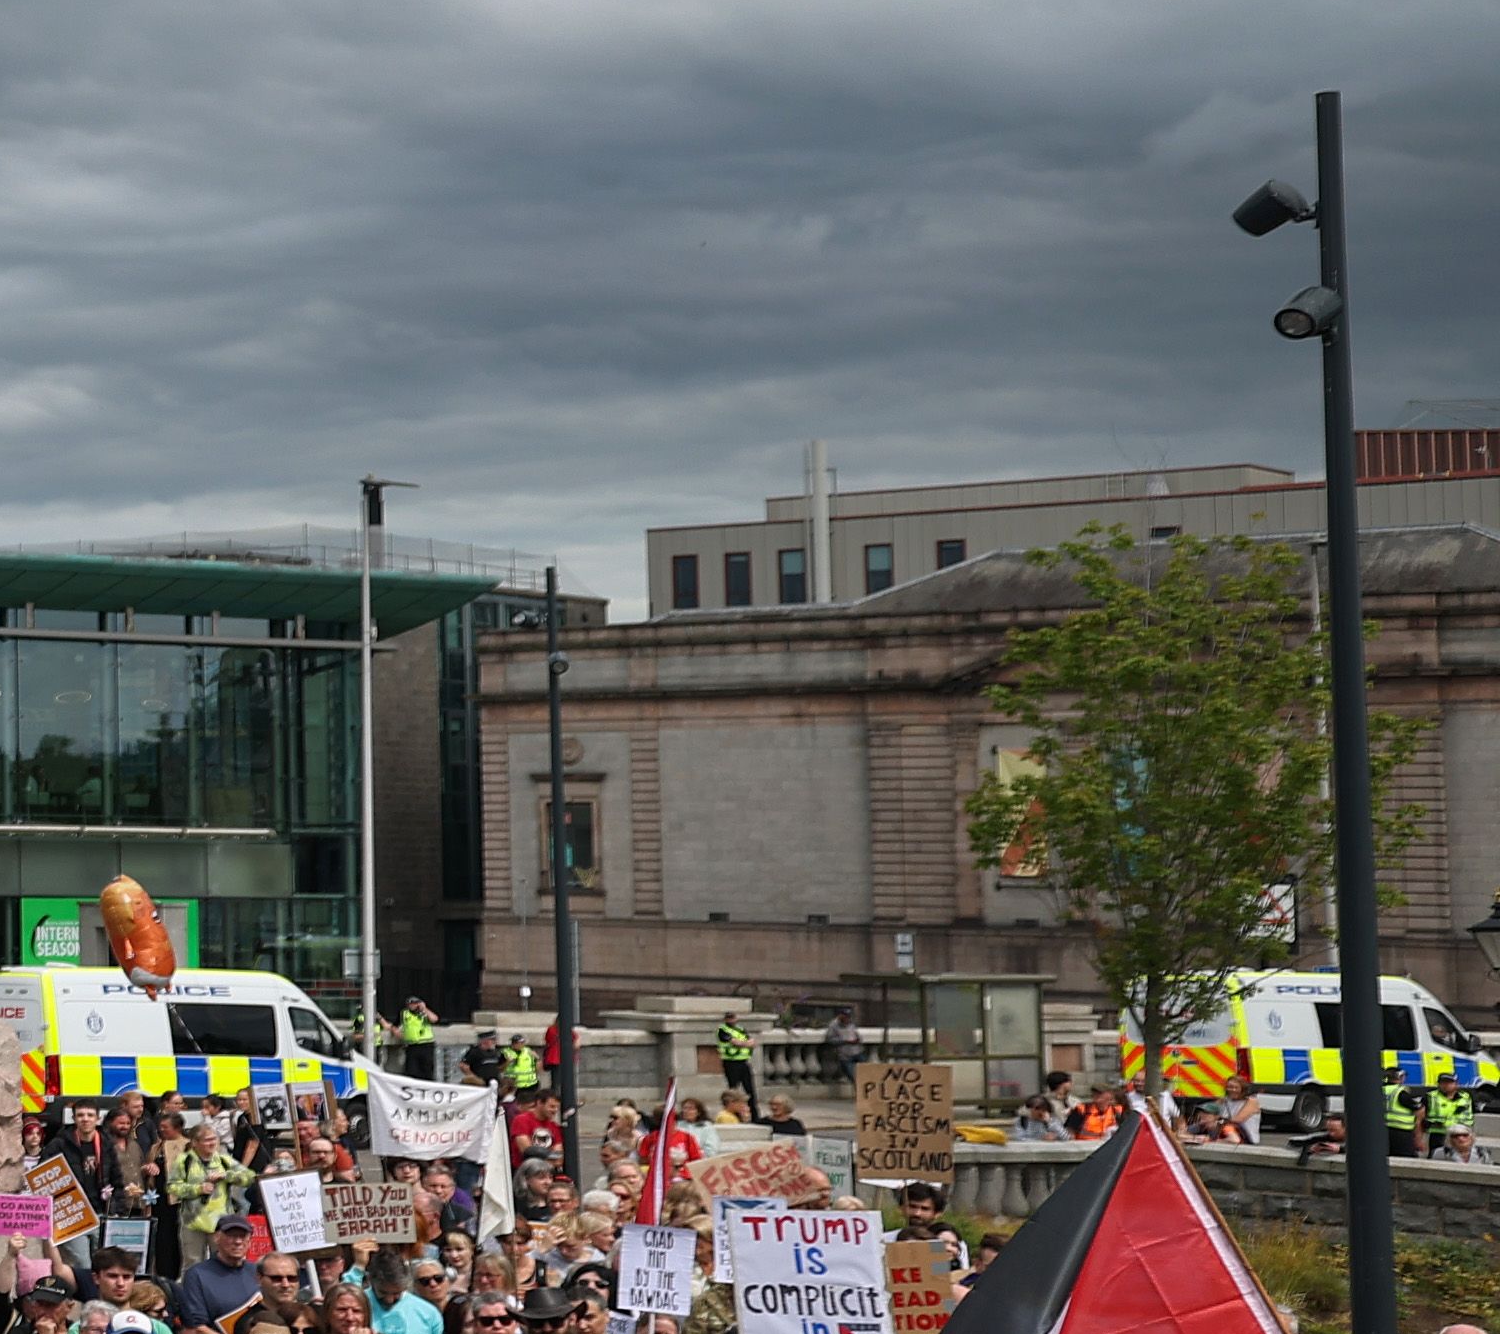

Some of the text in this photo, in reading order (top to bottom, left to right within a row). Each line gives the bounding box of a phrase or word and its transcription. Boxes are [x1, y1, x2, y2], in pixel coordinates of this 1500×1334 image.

[883, 1068, 922, 1082] NO
[401, 1086, 460, 1105] STOP
[864, 1081, 942, 1102] PLACE
[390, 1106, 466, 1123] ARMING
[888, 1101, 925, 1118] FOR
[861, 1116, 950, 1135] FASCISM
[389, 1128, 473, 1145] GENOCIDE
[888, 1135, 918, 1148] IN
[859, 1147, 953, 1171] SCOTLAND
[325, 1185, 407, 1209] TOLD YOU
